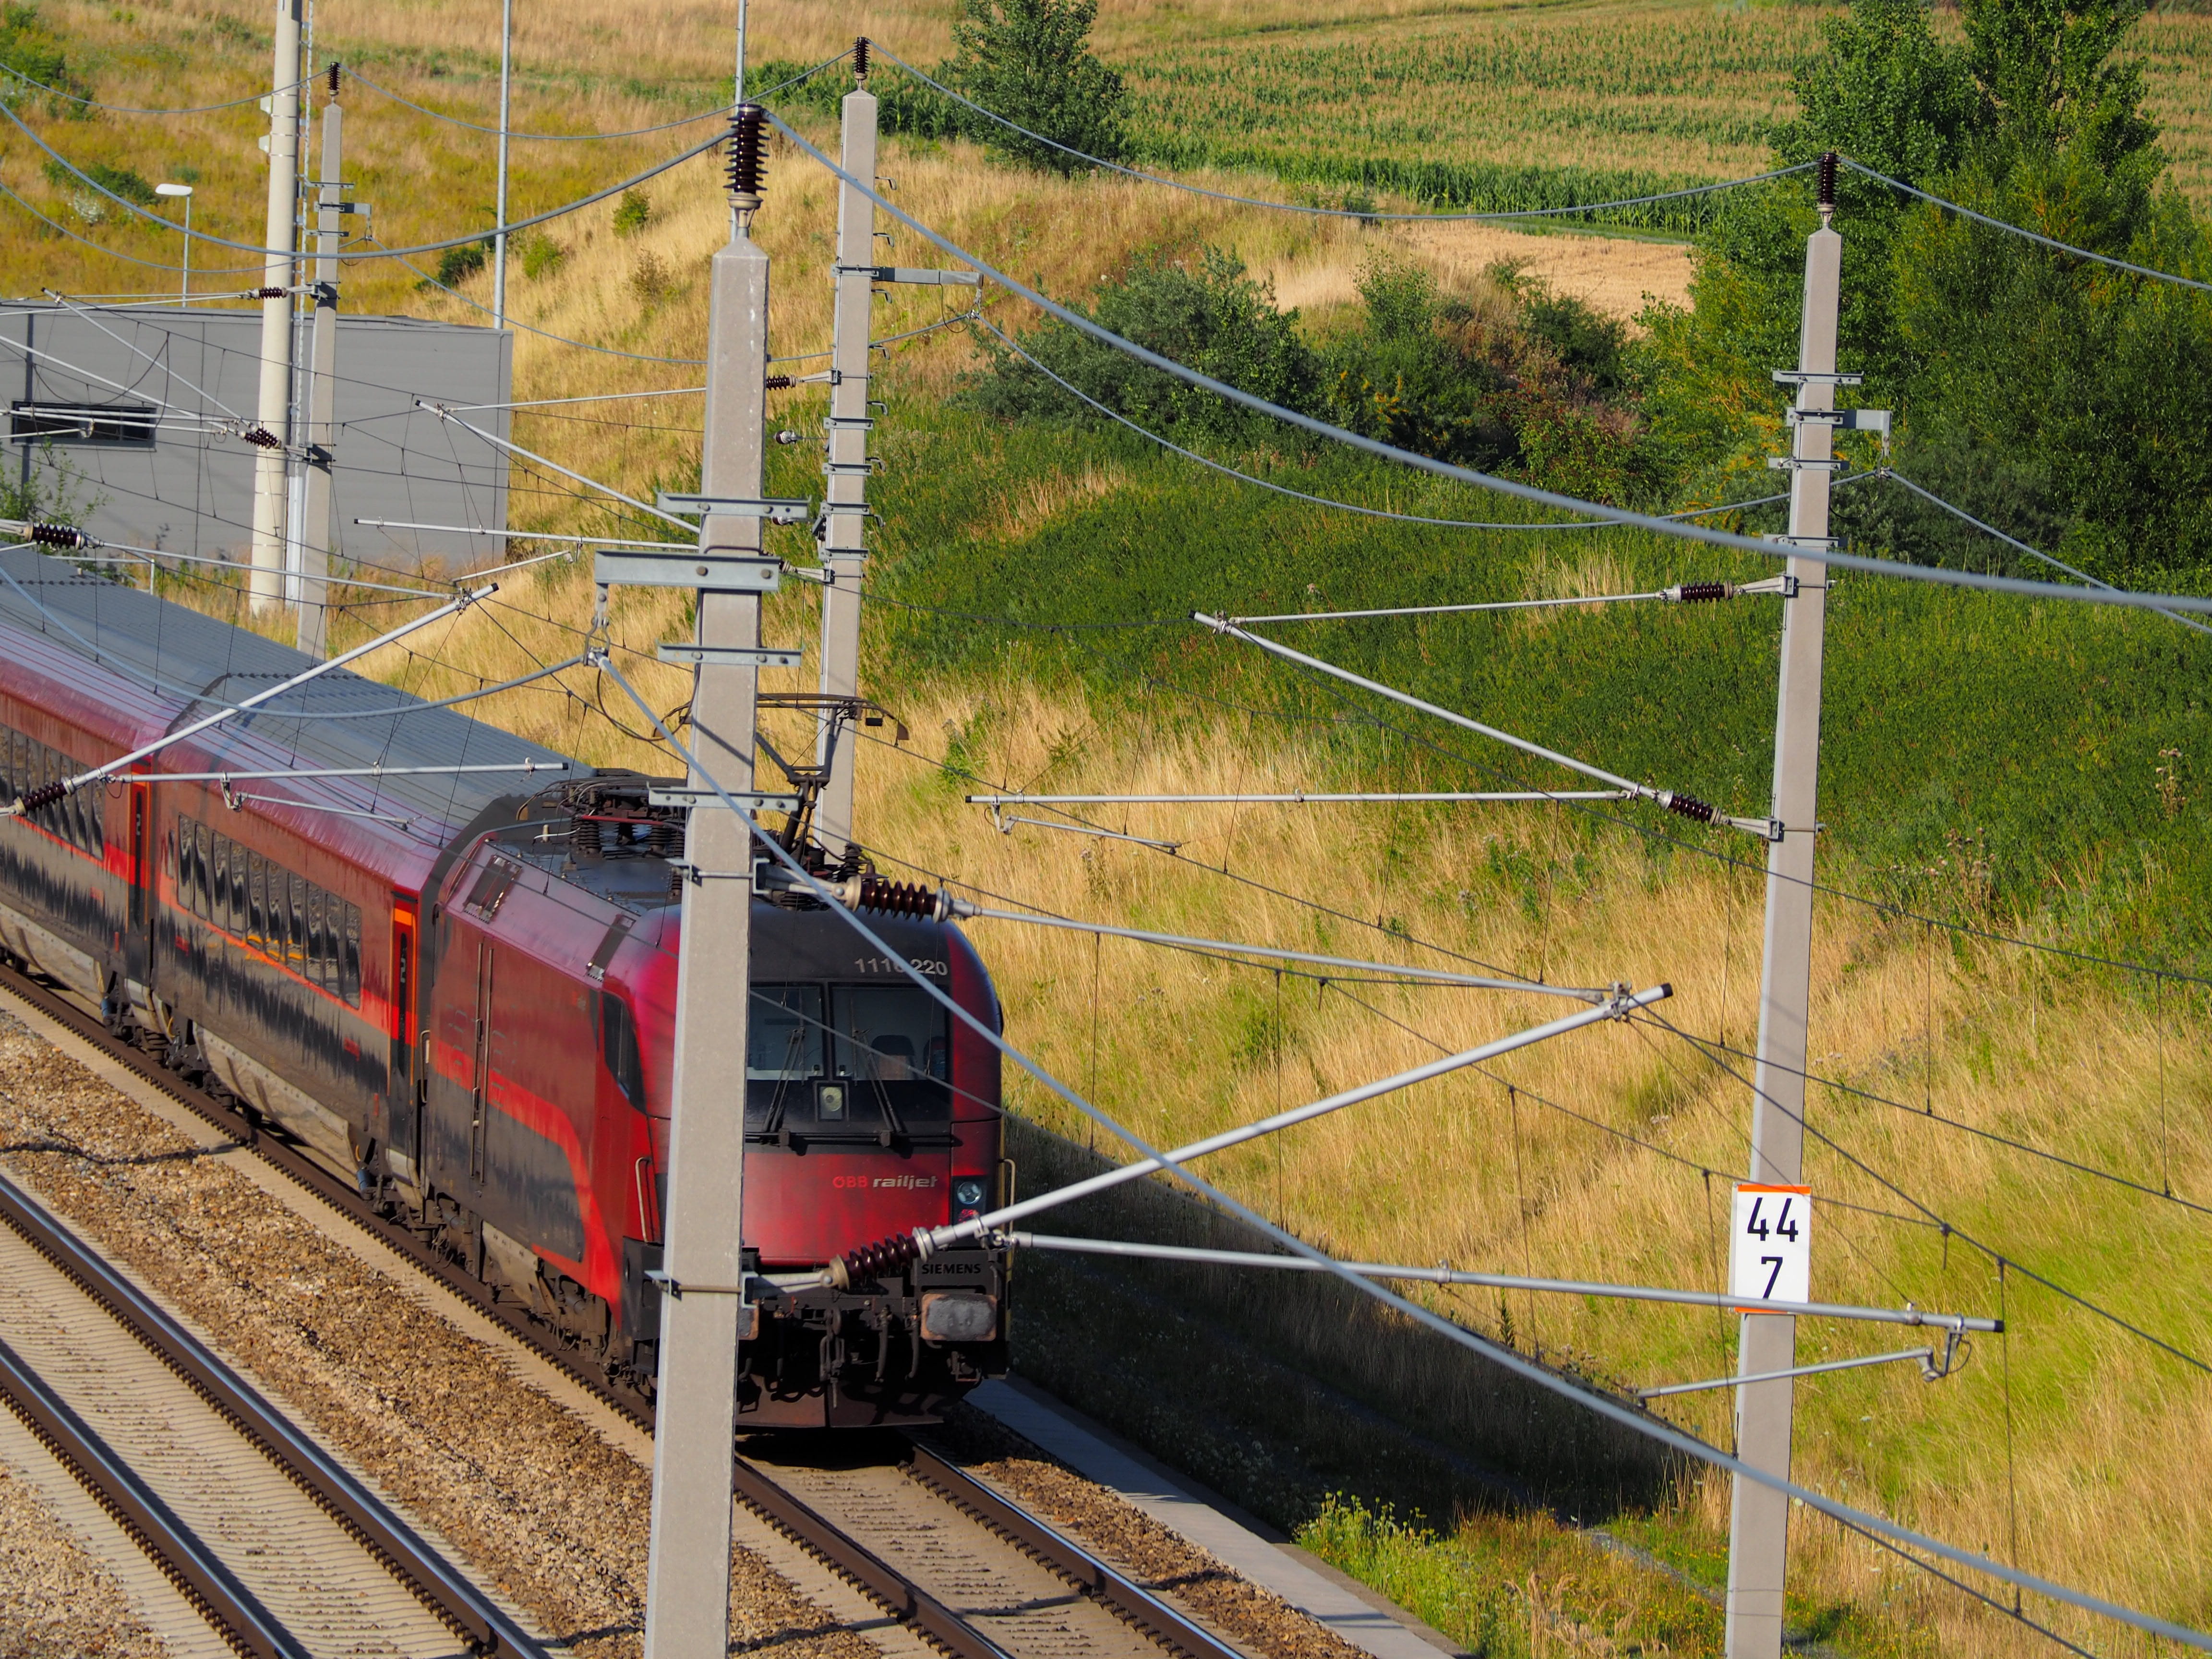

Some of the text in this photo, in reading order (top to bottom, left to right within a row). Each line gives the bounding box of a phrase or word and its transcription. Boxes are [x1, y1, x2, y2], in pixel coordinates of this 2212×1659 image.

[401, 958, 406, 983] 2
[911, 959, 948, 975] 220
[873, 1175, 938, 1190] railjet
[1747, 1197, 1798, 1242] 44
[922, 1263, 981, 1274] SIEMENS
[1761, 1256, 1783, 1299] 7
